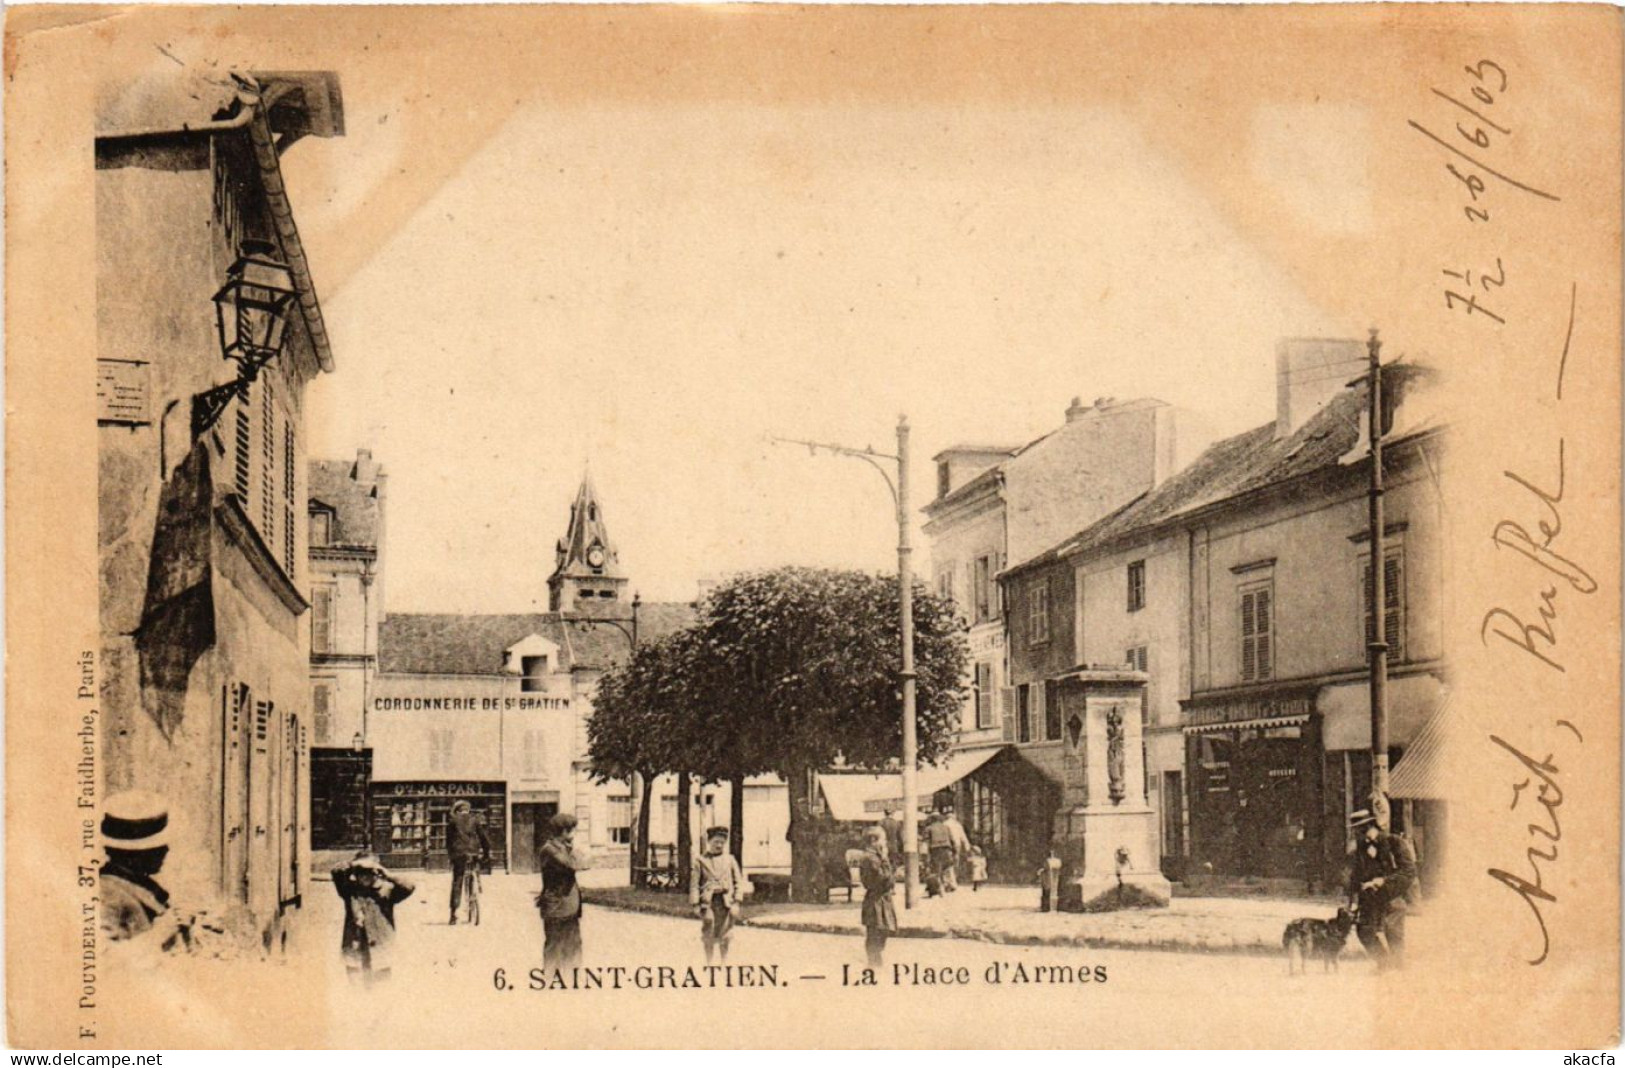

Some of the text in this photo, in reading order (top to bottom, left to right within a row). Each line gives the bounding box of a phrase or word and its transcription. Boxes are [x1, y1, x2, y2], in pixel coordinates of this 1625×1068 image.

[77, 650, 95, 700] Paris
[374, 697, 476, 711] CORDONNERIE
[482, 697, 500, 711] DE
[519, 696, 570, 710] GRATIEN
[77, 709, 98, 810] Faidherbe,
[82, 821, 96, 849] rue
[77, 858, 98, 888] 37,
[493, 968, 514, 991] 6.
[842, 964, 878, 986] La
[893, 963, 970, 986] Place
[985, 961, 1109, 985] d'Armes
[79, 1021, 96, 1040] F.
